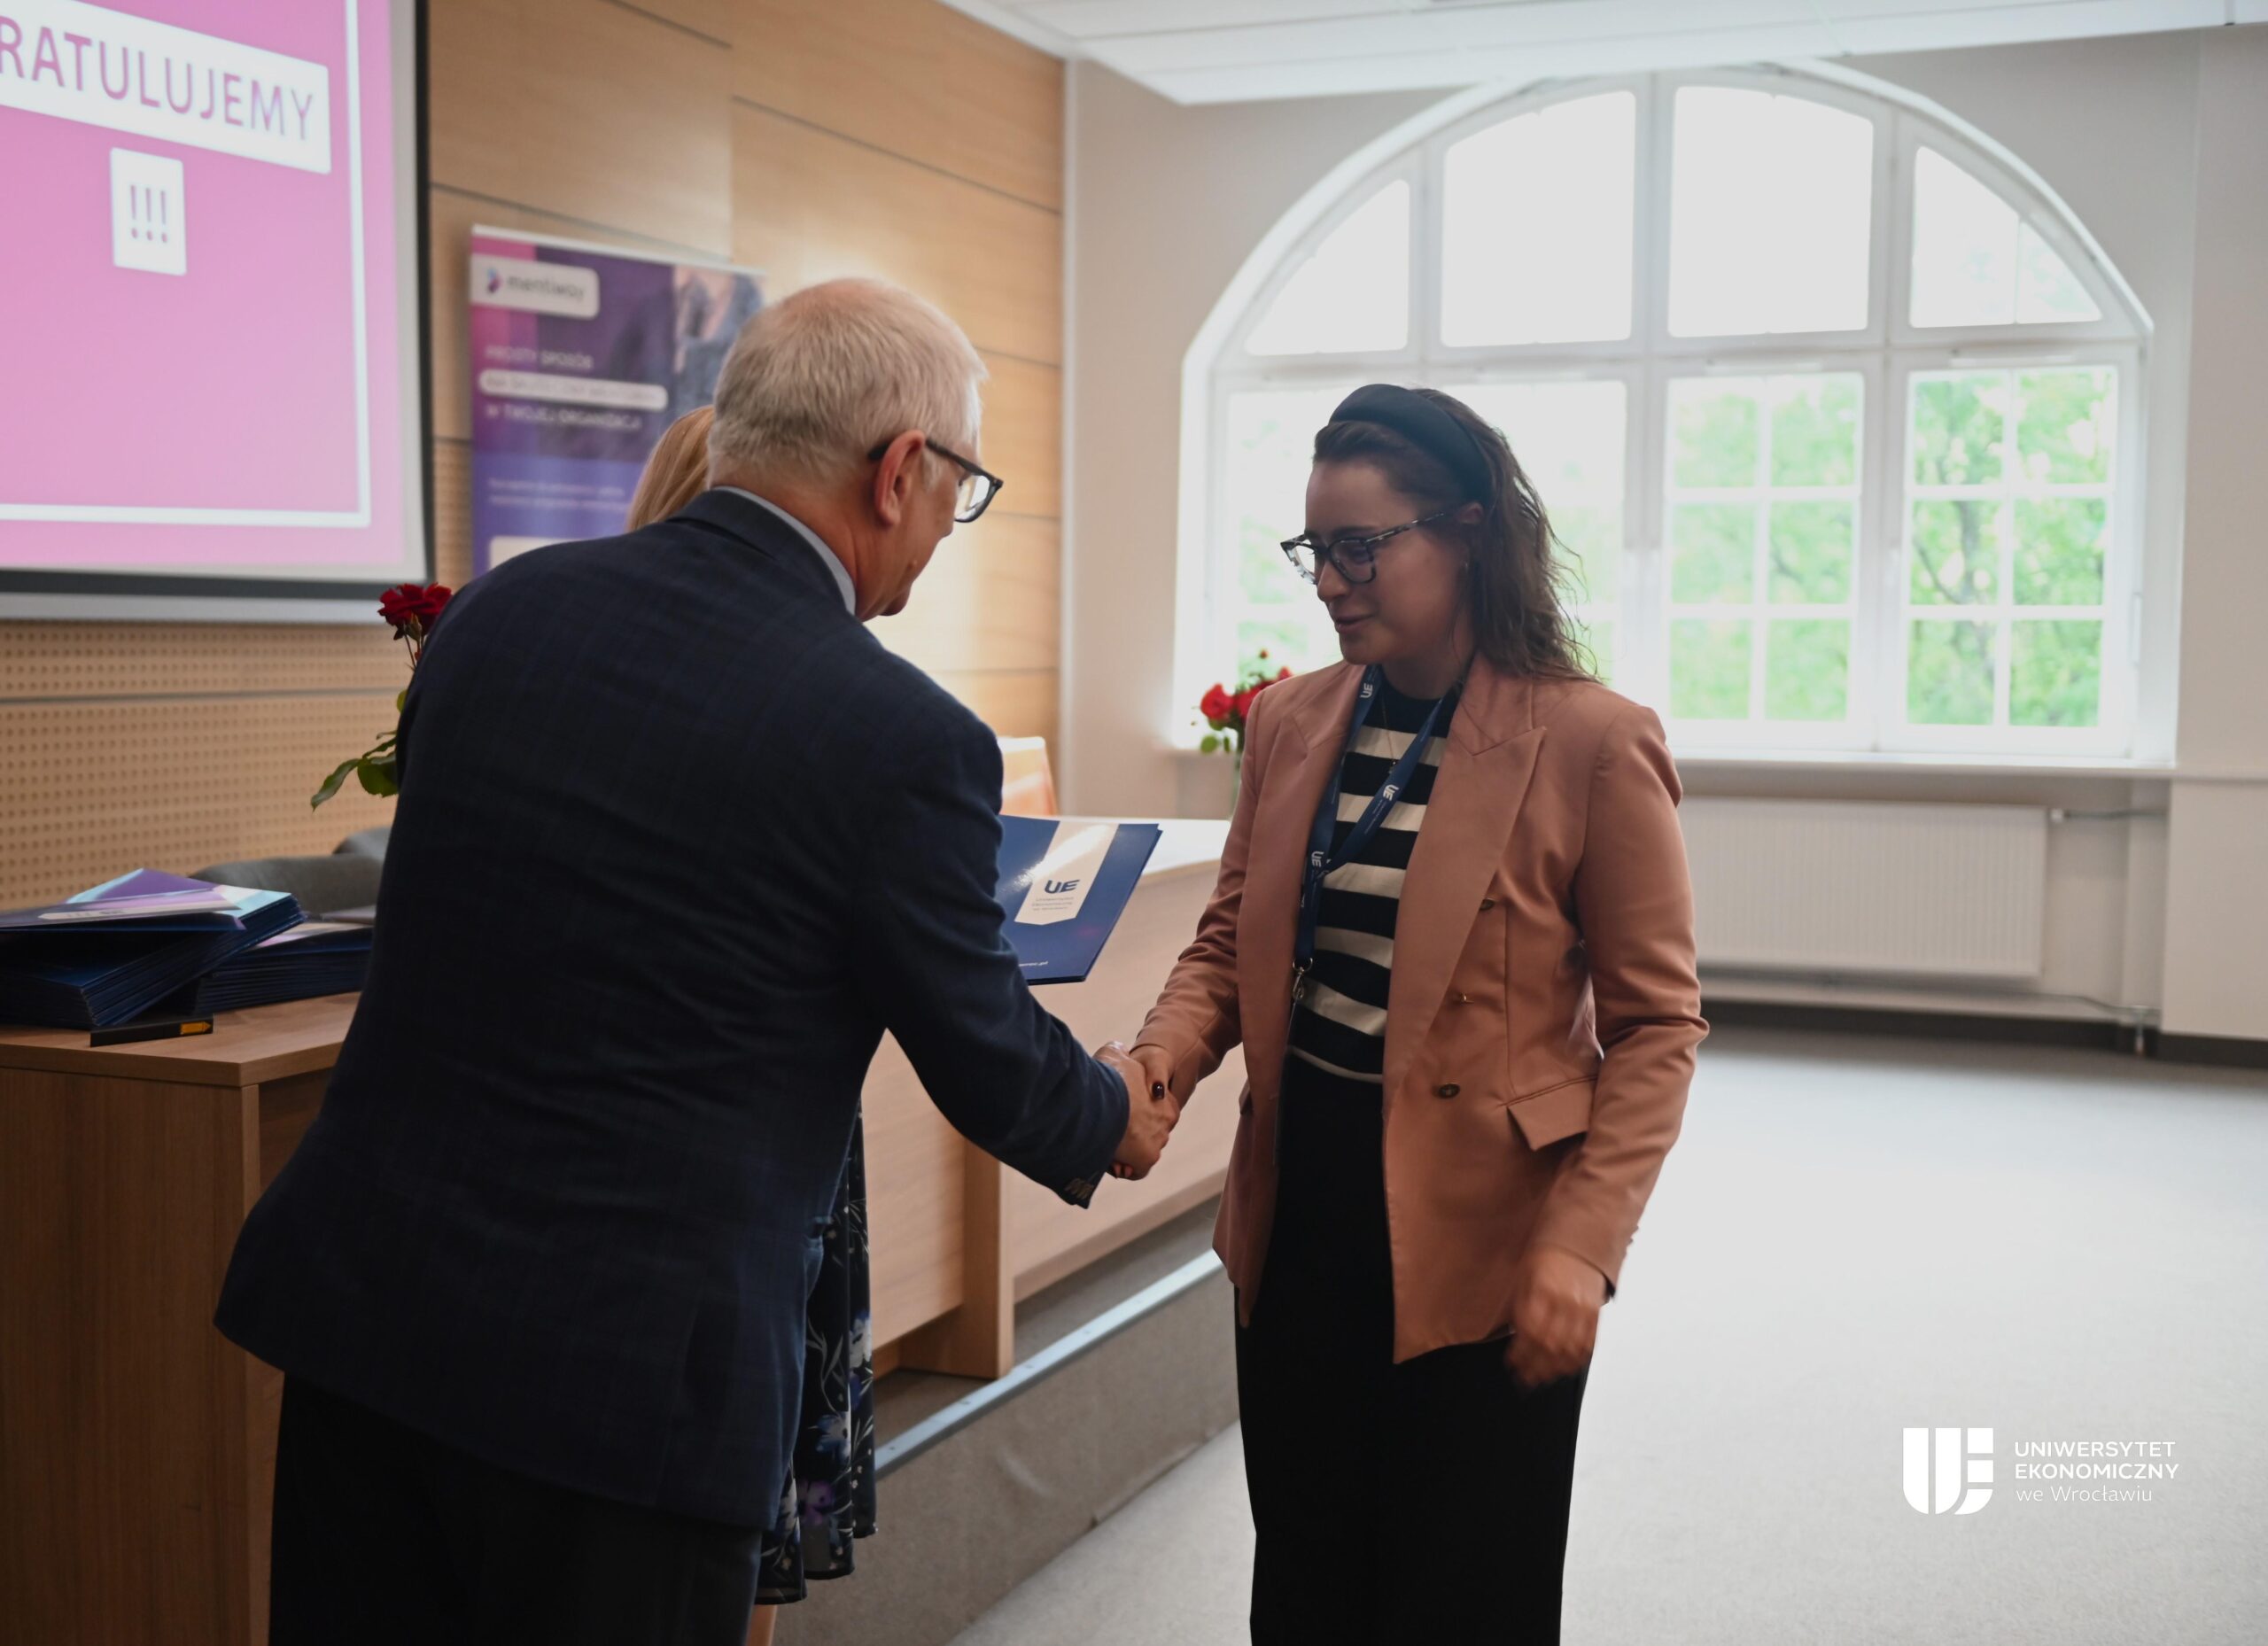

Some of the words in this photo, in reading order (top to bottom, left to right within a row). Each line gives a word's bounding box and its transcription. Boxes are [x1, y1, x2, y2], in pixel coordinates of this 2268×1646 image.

[129, 183, 168, 245] !!!
[1360, 682, 1373, 698] UE
[1383, 784, 1400, 801] UE
[1311, 850, 1324, 867] UE
[1045, 879, 1080, 894] UE
